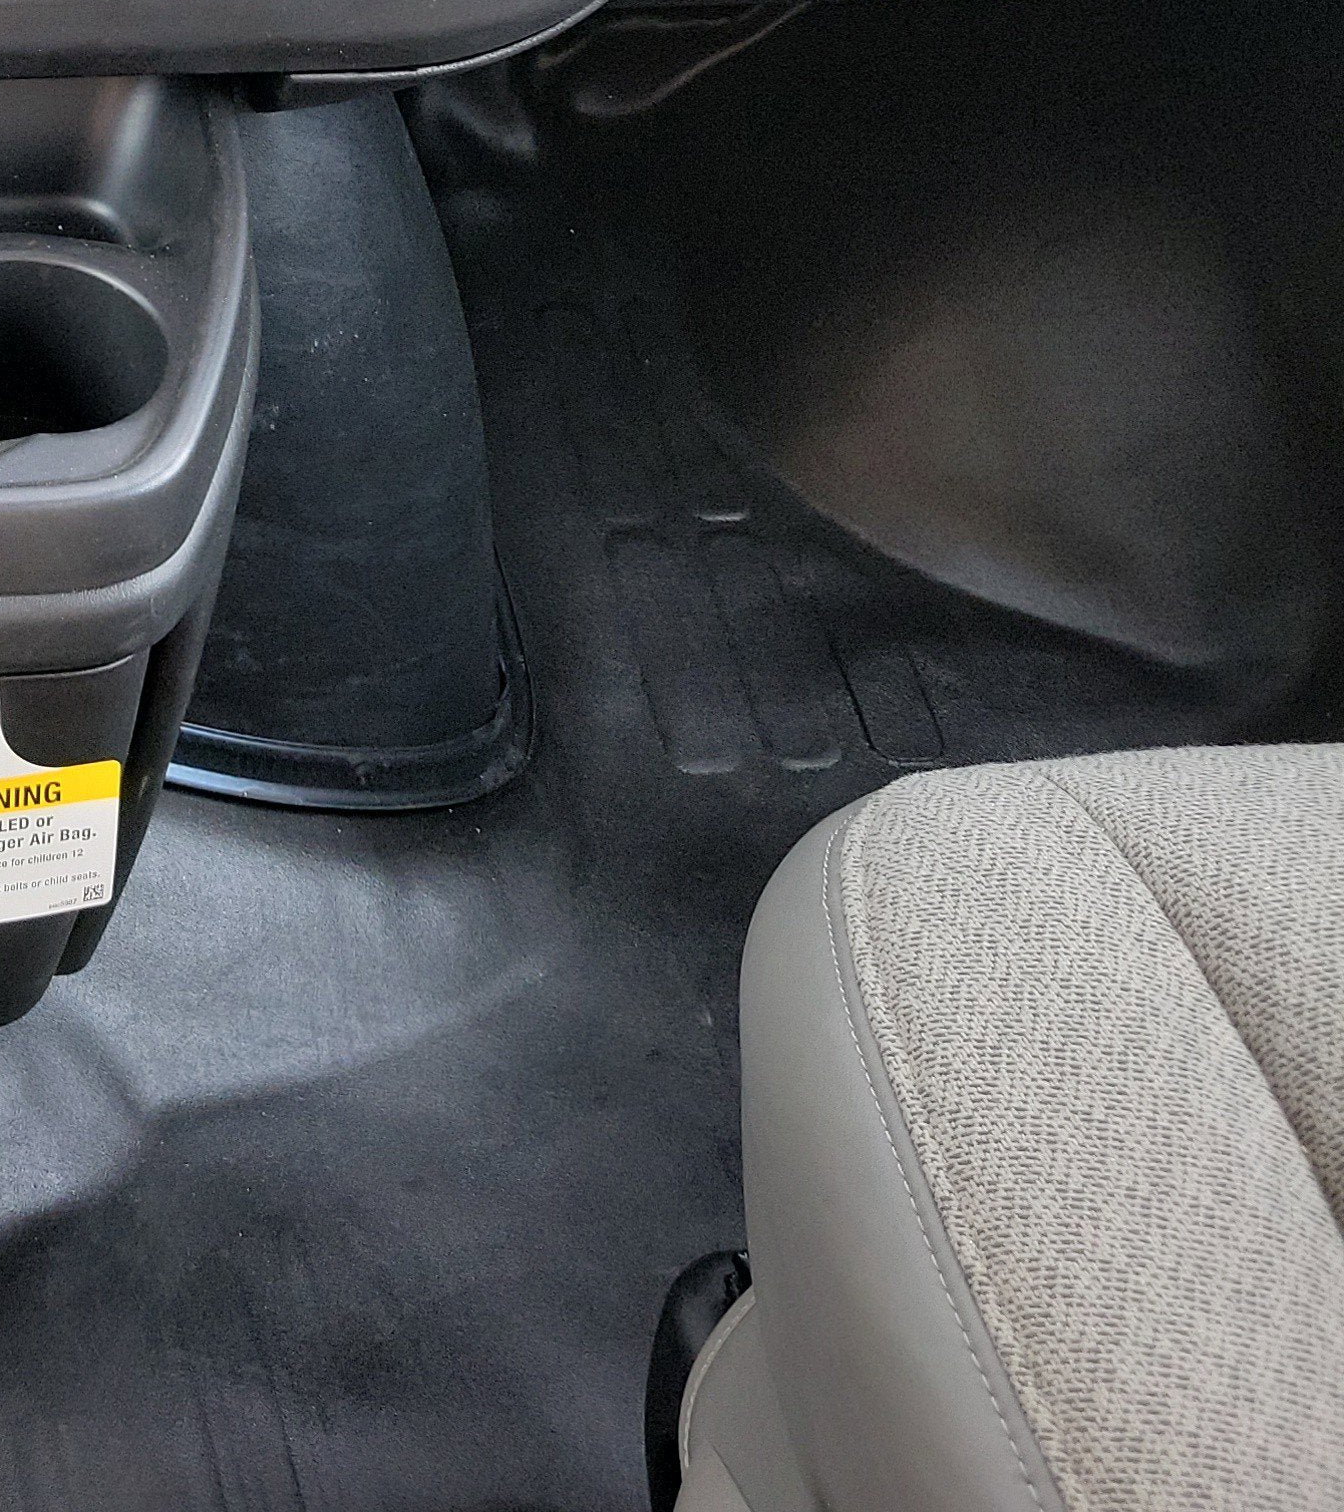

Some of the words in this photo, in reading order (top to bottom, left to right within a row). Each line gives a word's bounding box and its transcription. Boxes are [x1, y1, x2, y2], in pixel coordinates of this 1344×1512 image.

[36, 815, 54, 828] or
[29, 831, 55, 847] Air
[60, 827, 97, 842] Bag.
[11, 858, 26, 867] for
[27, 852, 68, 865] children
[71, 848, 84, 858] 12
[4, 881, 28, 892] belts
[31, 879, 42, 888] or
[44, 875, 68, 886] child
[71, 870, 101, 882] seats.
